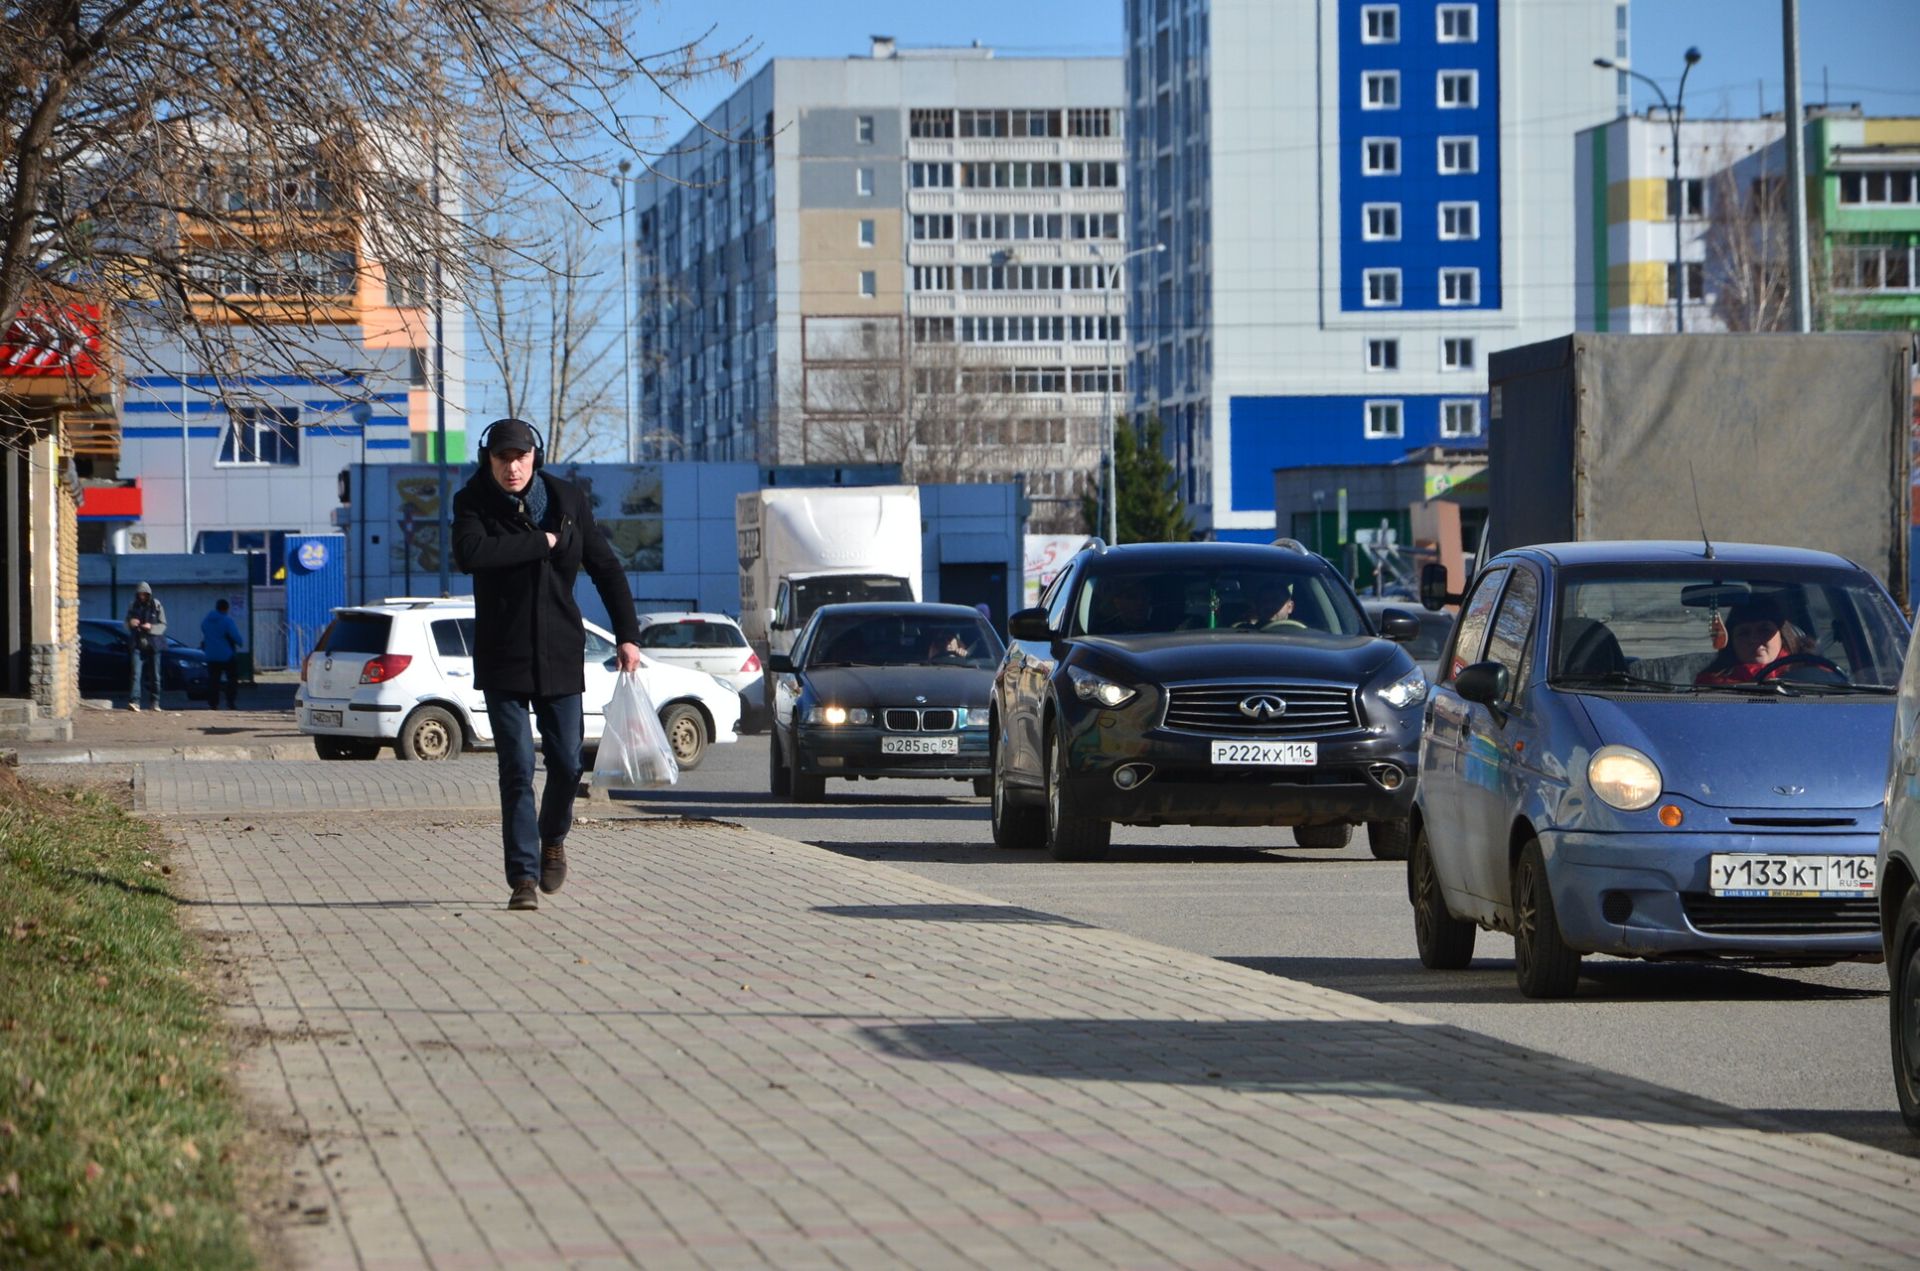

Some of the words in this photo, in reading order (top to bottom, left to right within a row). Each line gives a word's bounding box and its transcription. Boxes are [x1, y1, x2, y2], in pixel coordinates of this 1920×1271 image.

[303, 544, 324, 559] 24
[1287, 745, 1311, 758] 116
[1831, 860, 1869, 880] 116
